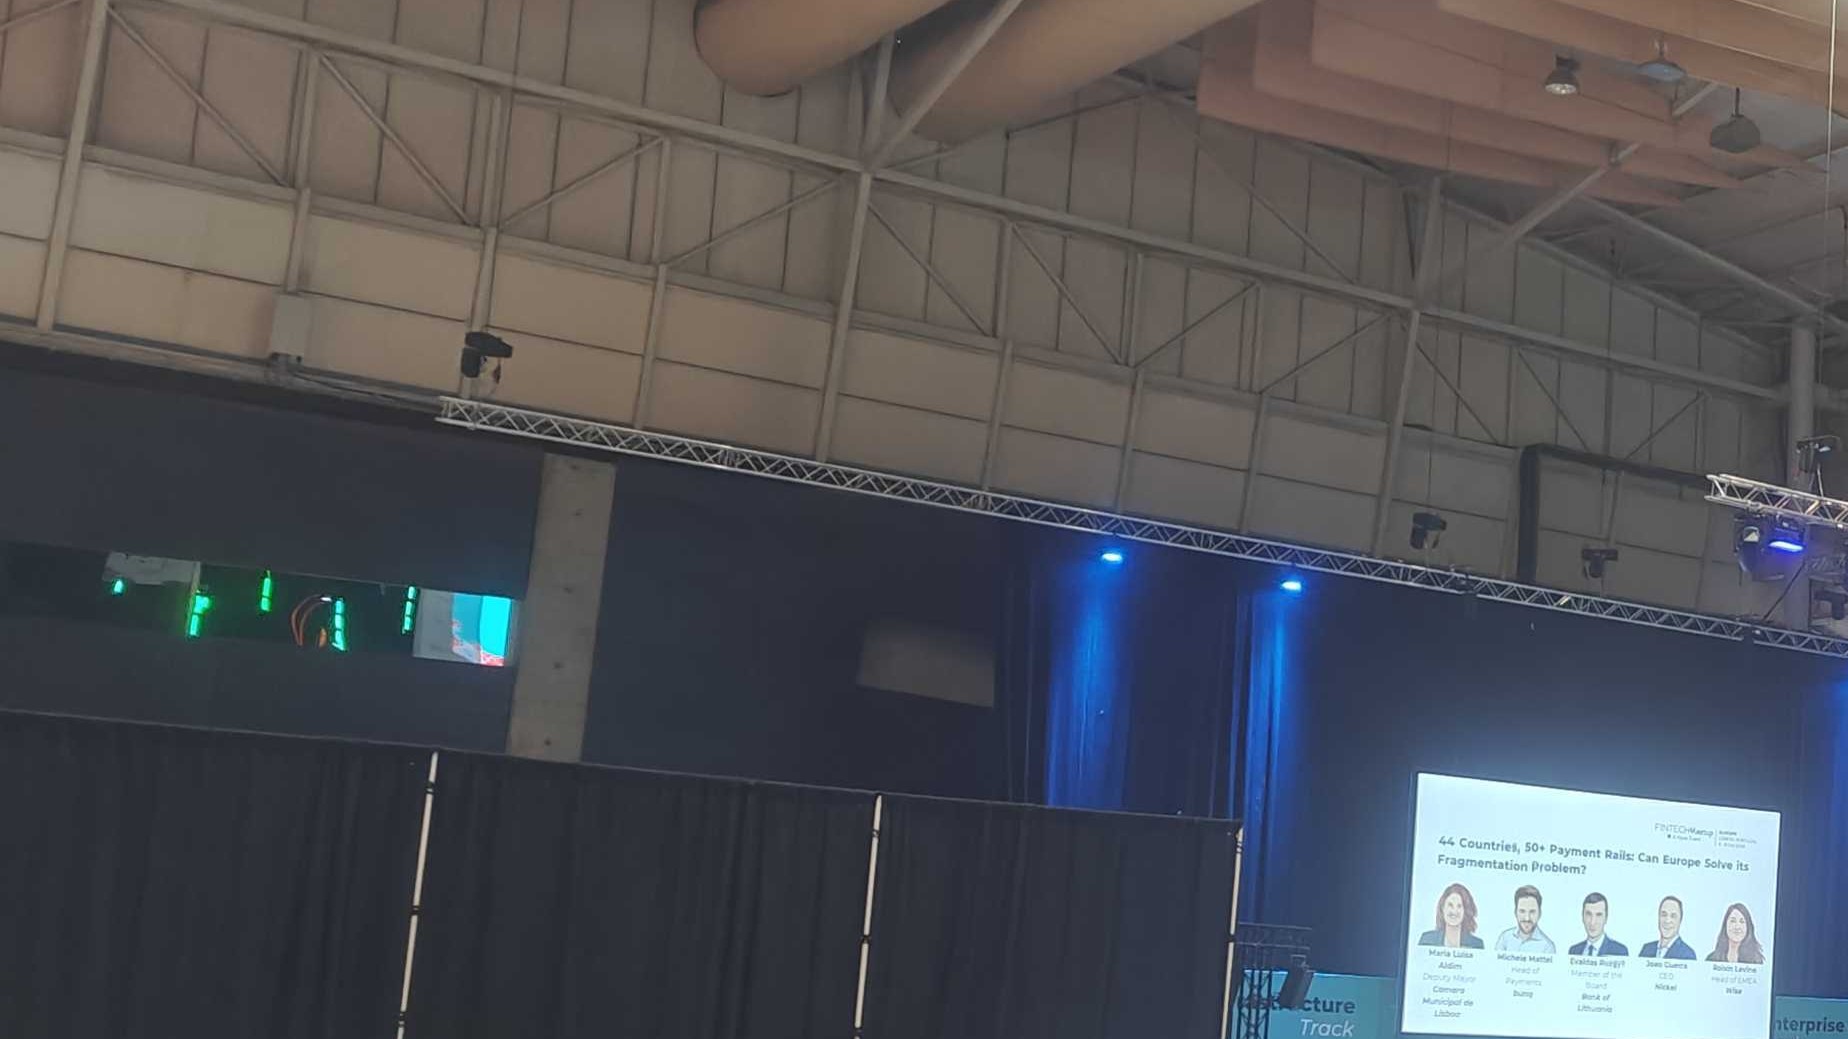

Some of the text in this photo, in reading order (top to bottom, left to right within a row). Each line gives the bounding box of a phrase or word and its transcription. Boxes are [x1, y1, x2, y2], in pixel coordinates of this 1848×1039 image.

[1438, 836, 1750, 871] 44 Countries, 50+ Payment Rails: Can Europe Solve its
[1437, 854, 1586, 874] Fragmentation Problem?
[1301, 1018, 1355, 1037] Track
[1775, 1016, 1844, 1036] nterprise
